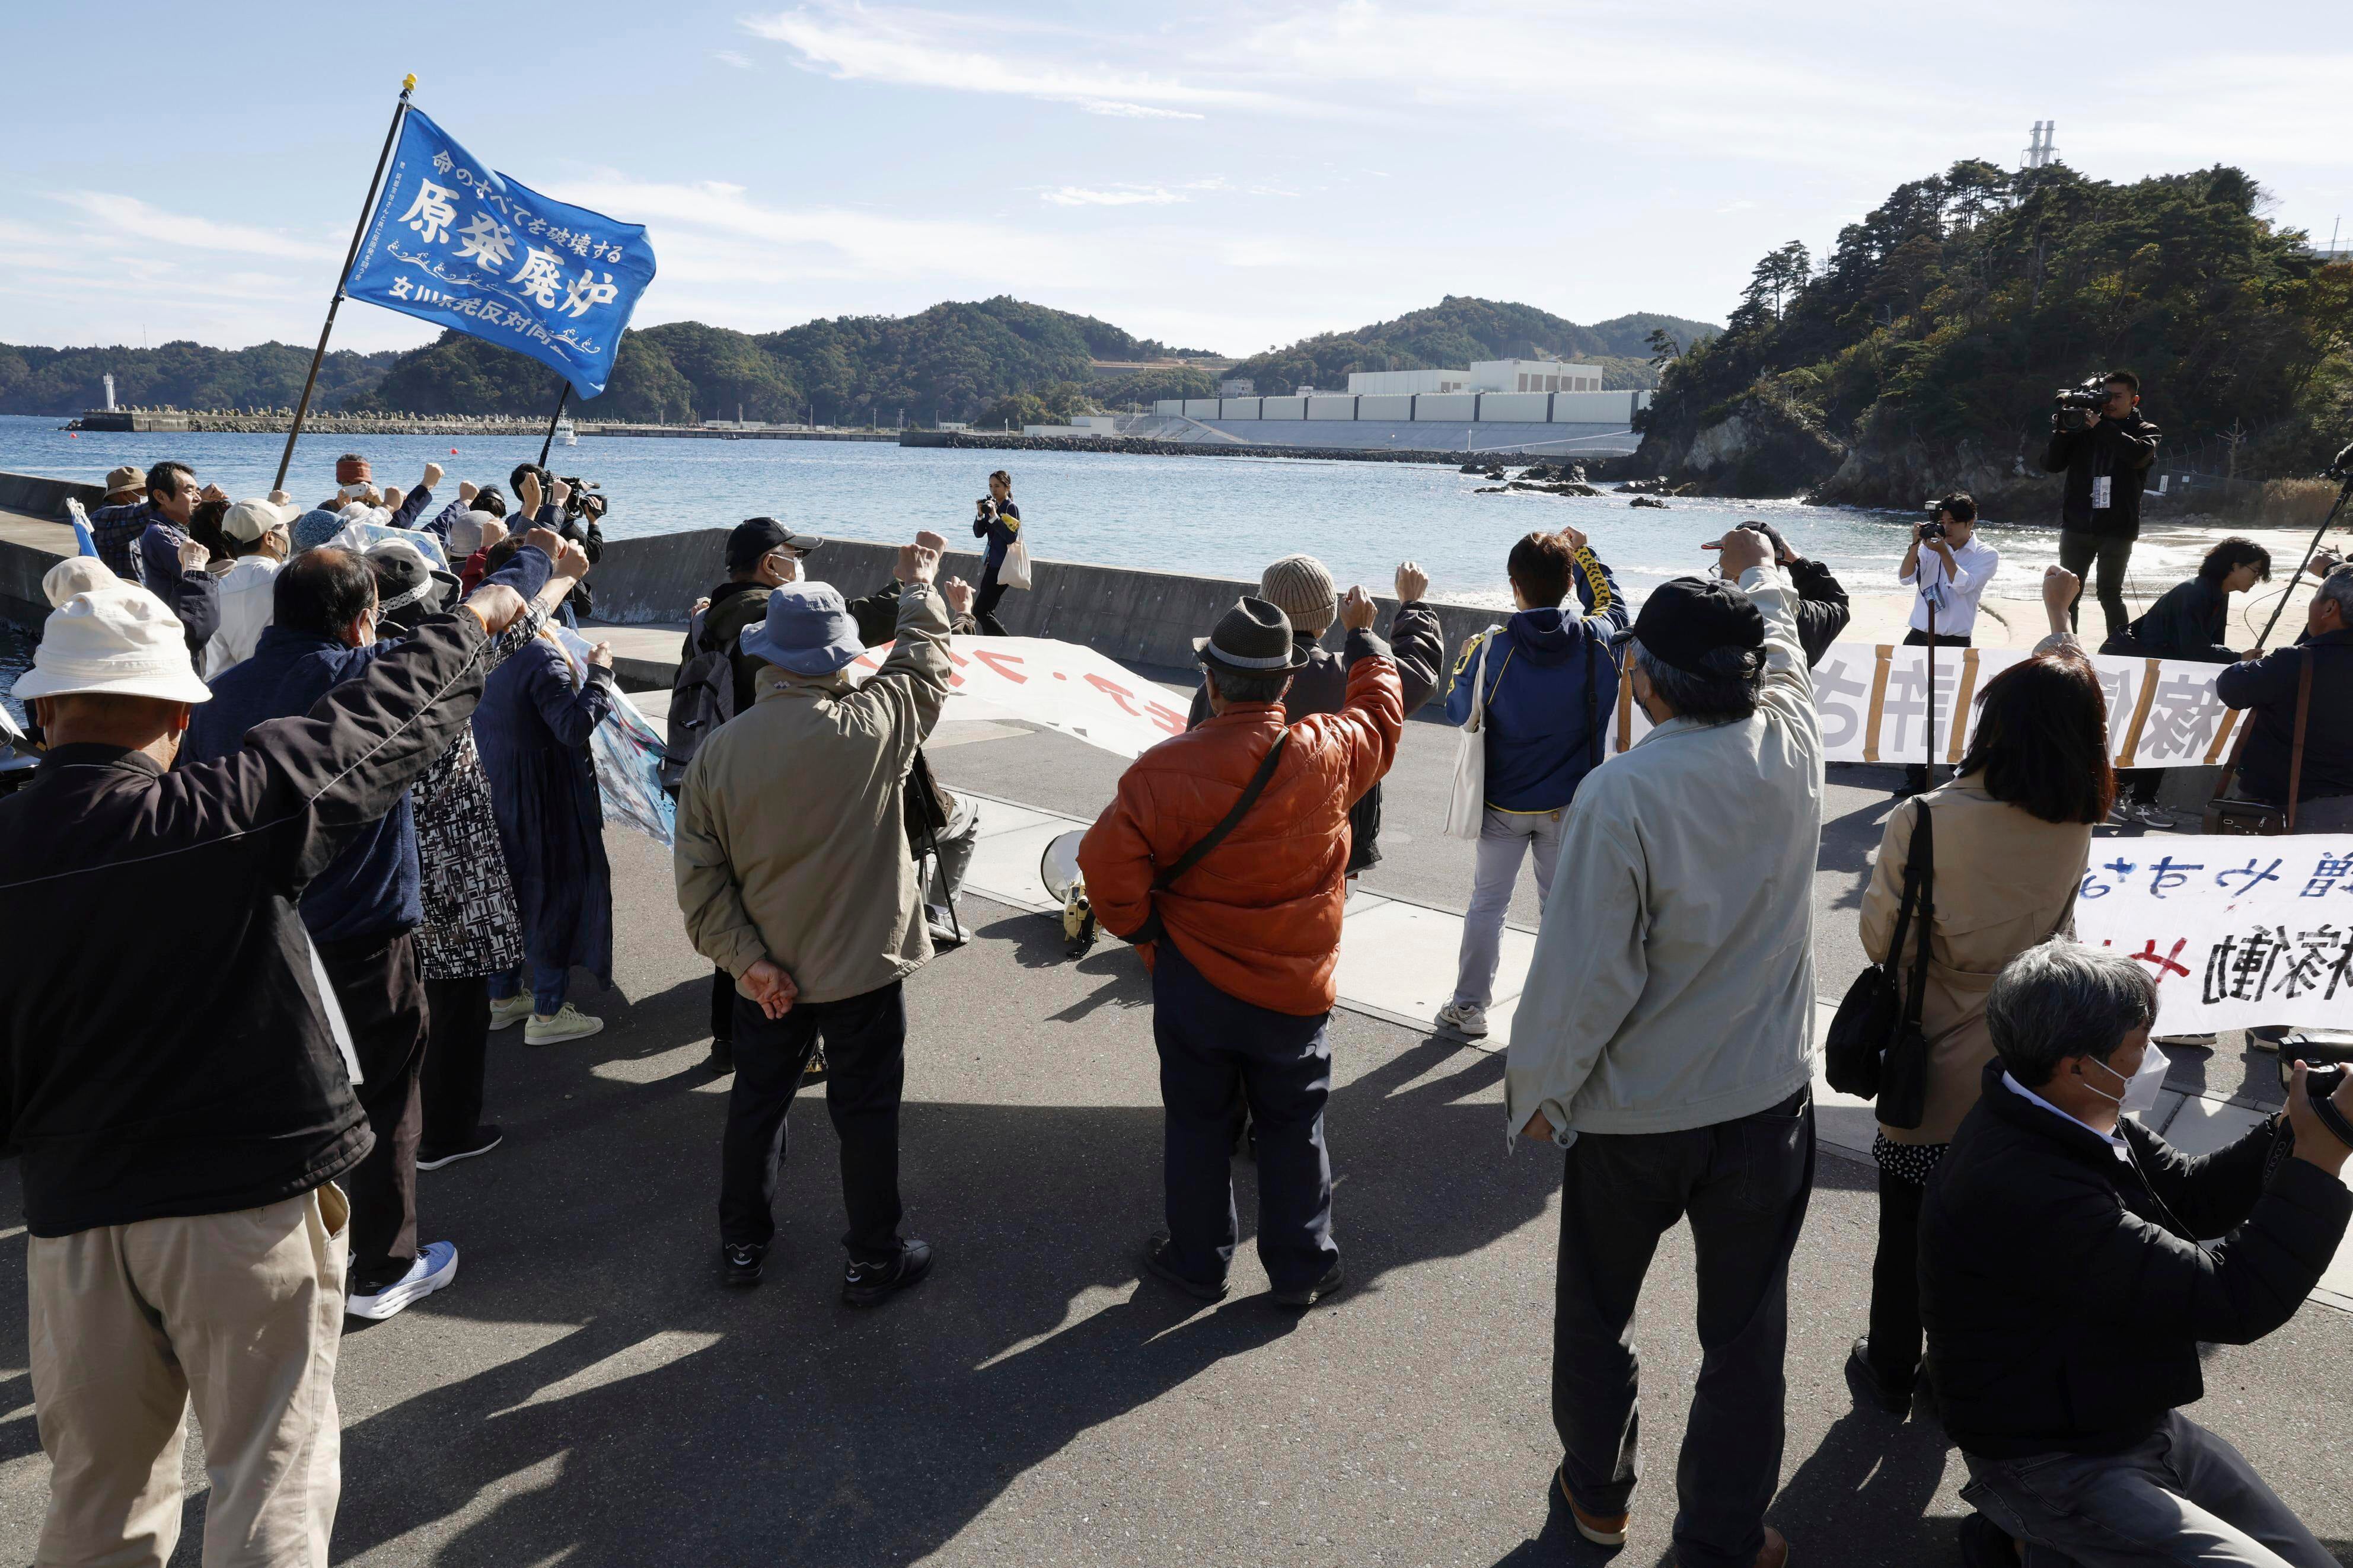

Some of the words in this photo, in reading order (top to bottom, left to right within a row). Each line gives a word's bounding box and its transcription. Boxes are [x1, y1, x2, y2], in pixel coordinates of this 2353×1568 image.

[397, 178, 618, 318] 原発廃炉
[432, 149, 623, 263] 命のすべてを破壊する
